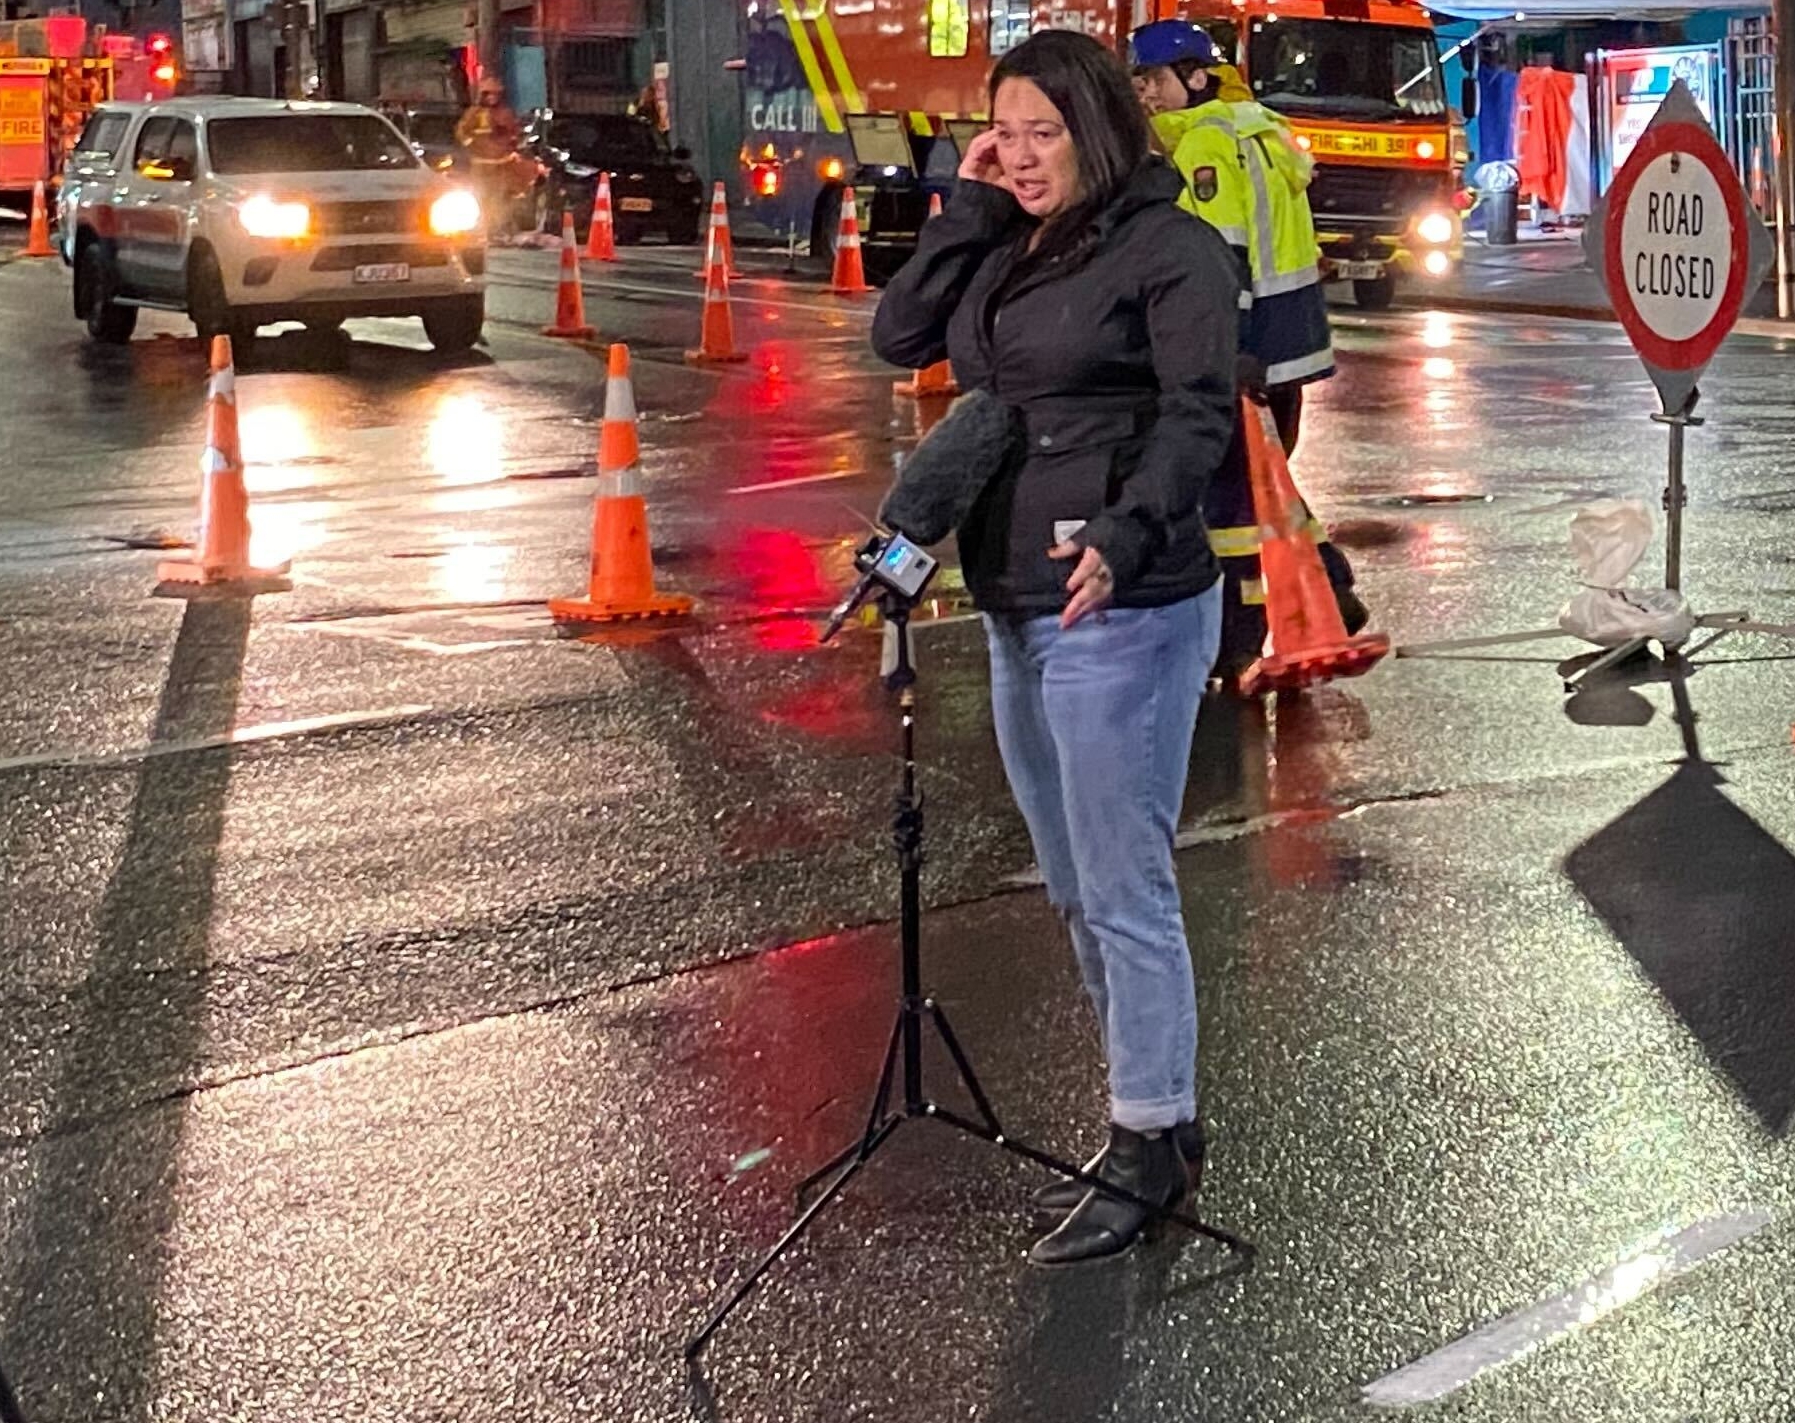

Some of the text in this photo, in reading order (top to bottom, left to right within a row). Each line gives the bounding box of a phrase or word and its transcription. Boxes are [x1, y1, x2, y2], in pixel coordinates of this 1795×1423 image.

[2, 121, 42, 135] FIRE
[751, 104, 797, 132] CALL
[1648, 191, 1703, 236] ROAD
[1636, 251, 1714, 299] CLOSED
